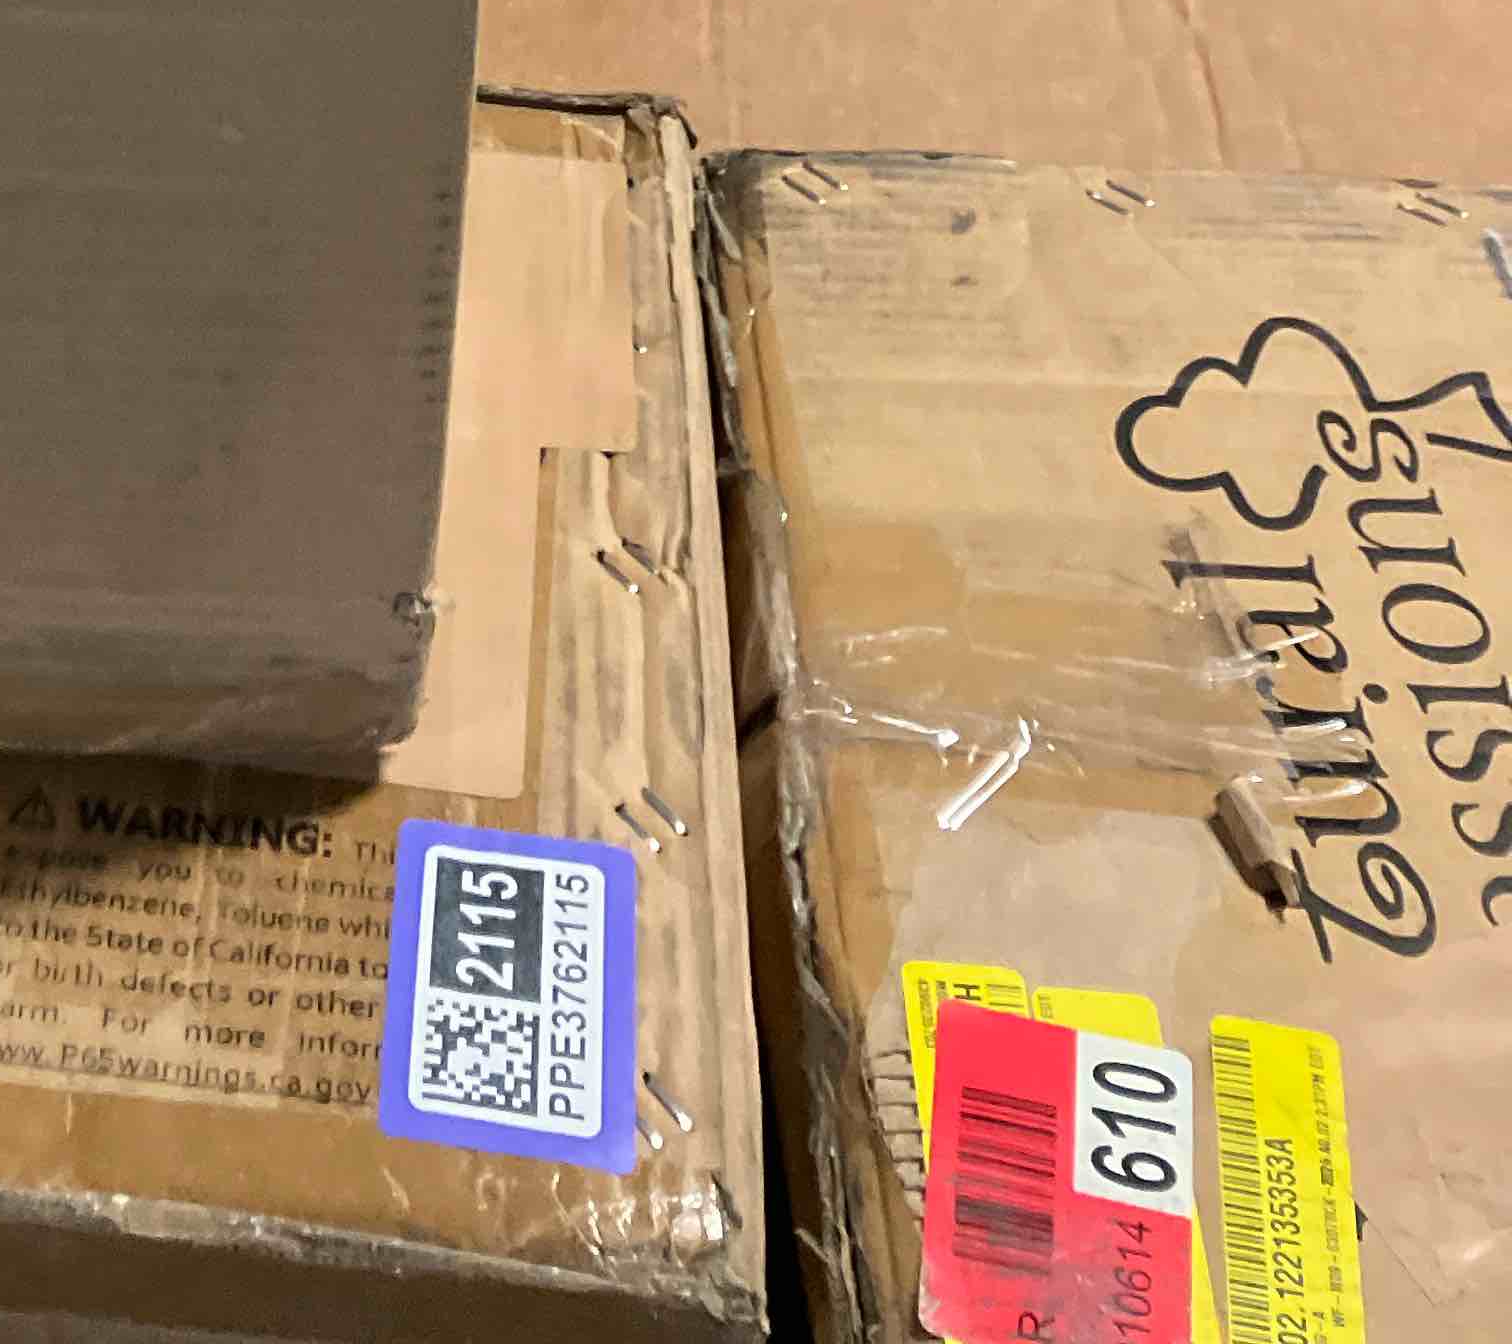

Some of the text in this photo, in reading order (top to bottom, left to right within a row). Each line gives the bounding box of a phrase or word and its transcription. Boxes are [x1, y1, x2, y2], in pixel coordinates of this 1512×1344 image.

[76, 796, 333, 859] WARNING:
[137, 861, 192, 883] you
[31, 917, 77, 944] the
[87, 926, 165, 957] State
[173, 936, 205, 958] of
[208, 939, 350, 977] California
[359, 957, 389, 981] to
[455, 869, 519, 992] 2115
[120, 969, 233, 1004] defects
[247, 986, 281, 1009] or
[295, 989, 380, 1019] other
[548, 872, 589, 1121] PPE3762115
[102, 1008, 153, 1036] For
[184, 1024, 267, 1050] more
[1090, 1061, 1178, 1193] 610
[1112, 1216, 1154, 1344] 10614
